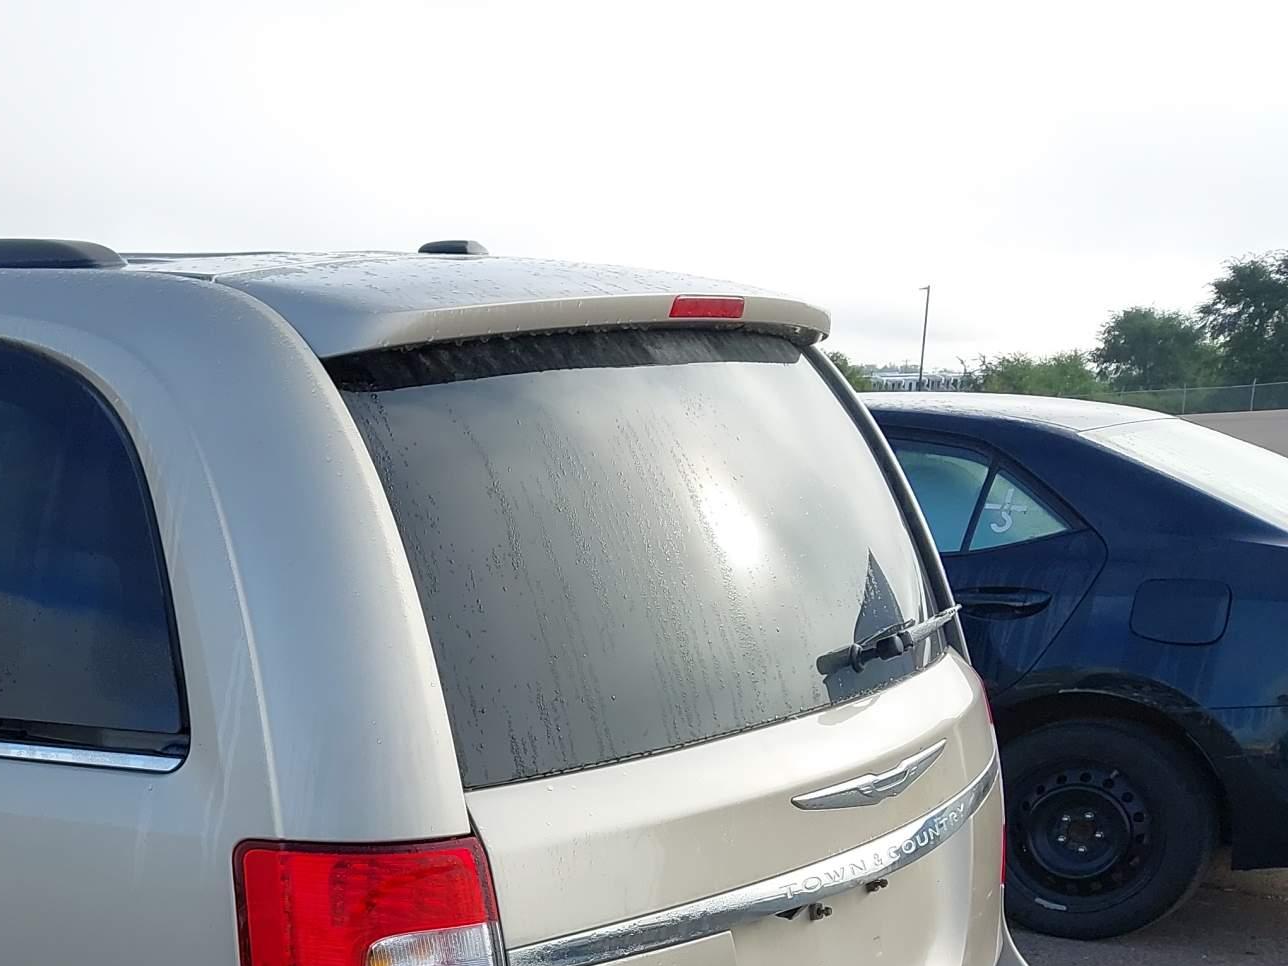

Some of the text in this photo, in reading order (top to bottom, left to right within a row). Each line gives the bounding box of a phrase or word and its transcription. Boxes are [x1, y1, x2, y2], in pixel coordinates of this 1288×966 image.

[778, 803, 966, 899] TOWN & COUNTRY
